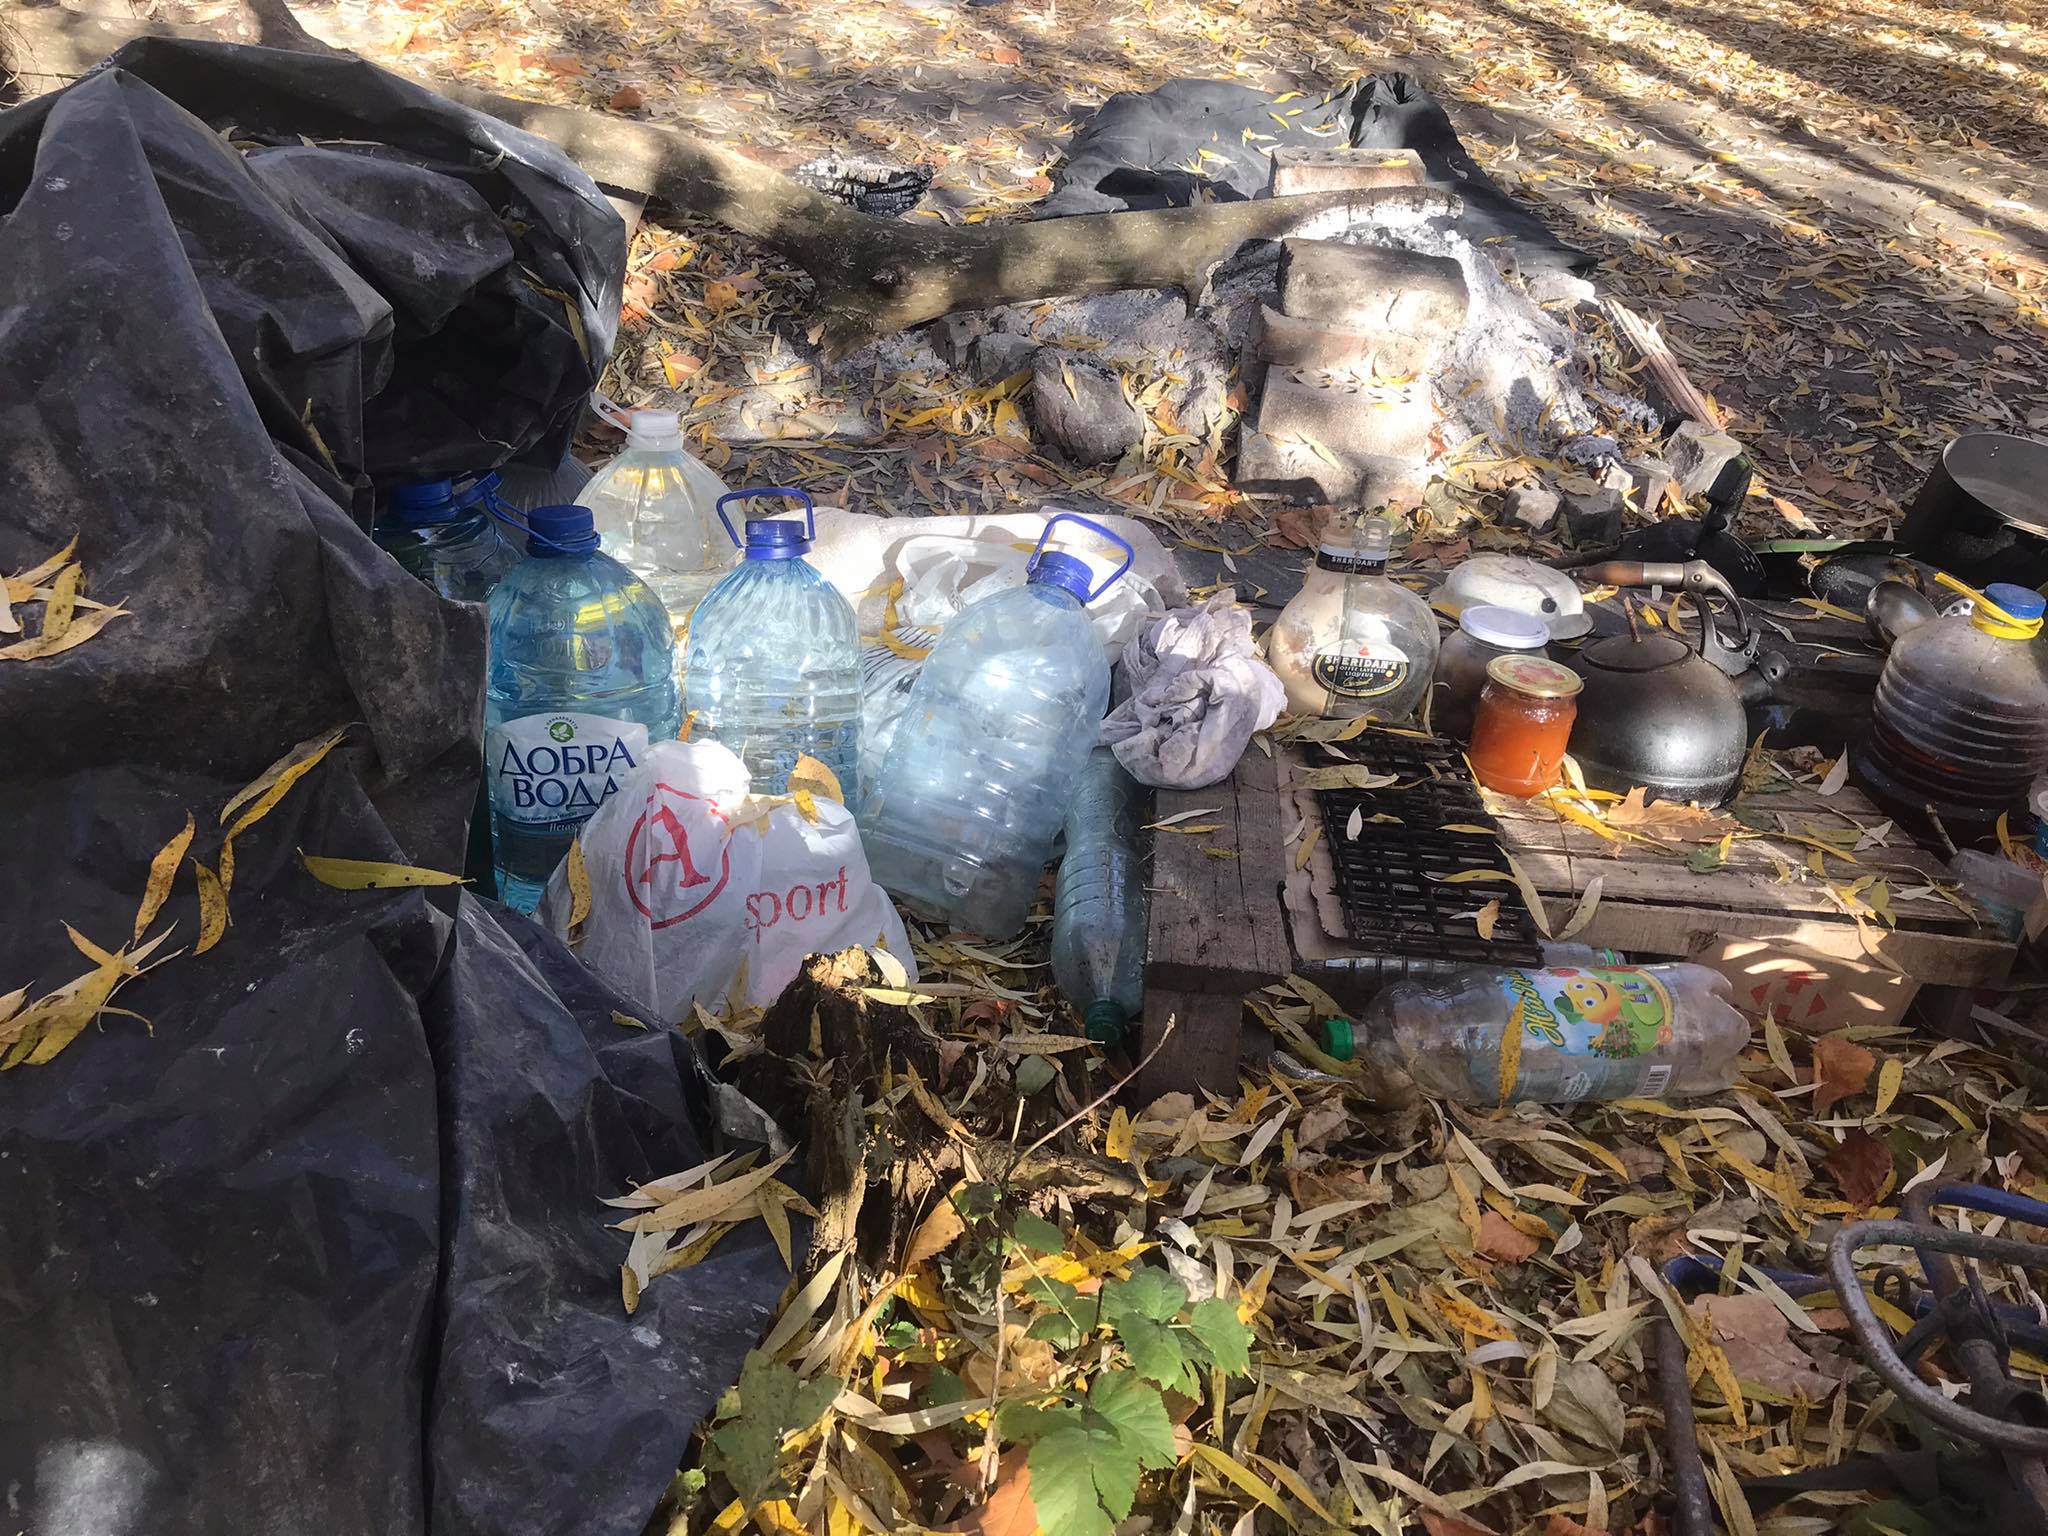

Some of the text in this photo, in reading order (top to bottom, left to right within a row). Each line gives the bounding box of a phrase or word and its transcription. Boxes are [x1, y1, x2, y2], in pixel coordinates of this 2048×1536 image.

[1324, 655, 1398, 670] SHERIDAN'S
[499, 736, 637, 781] ДОБРА
[513, 775, 619, 810] ВОДА
[744, 865, 849, 945] sport
